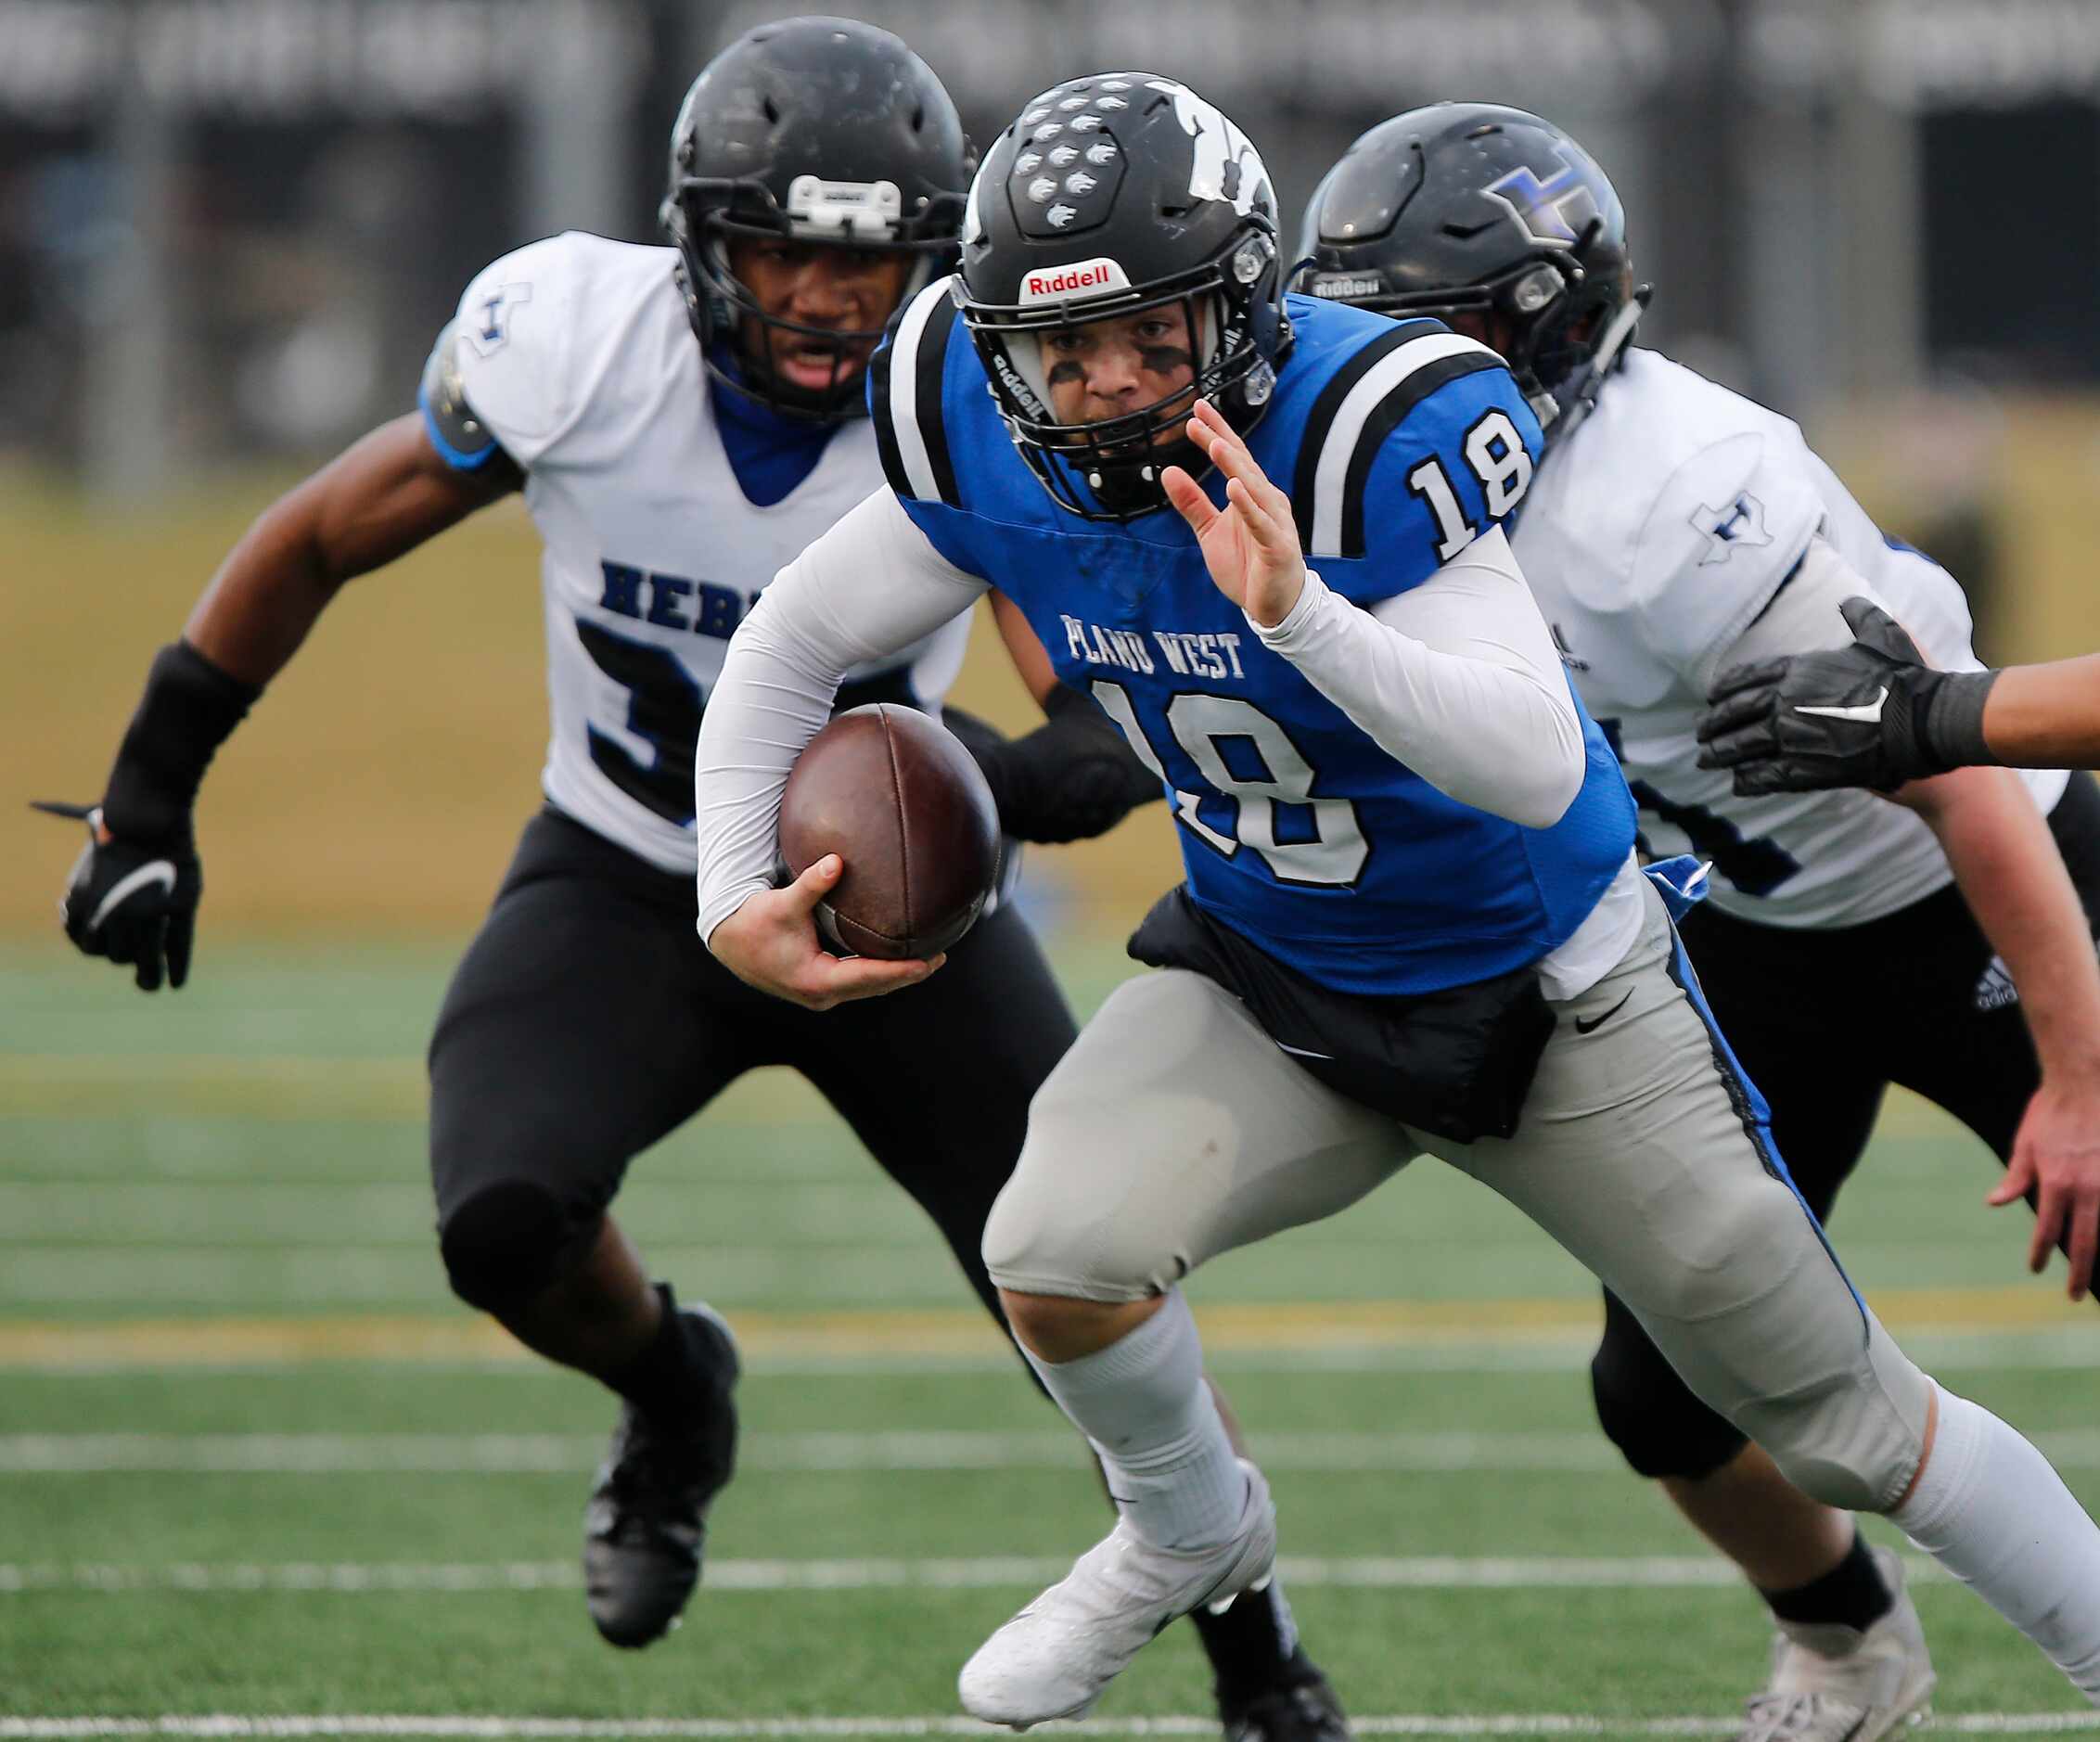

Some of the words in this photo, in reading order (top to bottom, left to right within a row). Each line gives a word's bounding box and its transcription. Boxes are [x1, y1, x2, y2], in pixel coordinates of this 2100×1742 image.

[1029, 264, 1110, 296] Riddell
[1406, 407, 1533, 565] 18
[601, 557, 762, 641] HEB
[1058, 613, 1156, 675] PLANO
[1151, 630, 1246, 680] WEST
[1091, 679, 1371, 886] 18
